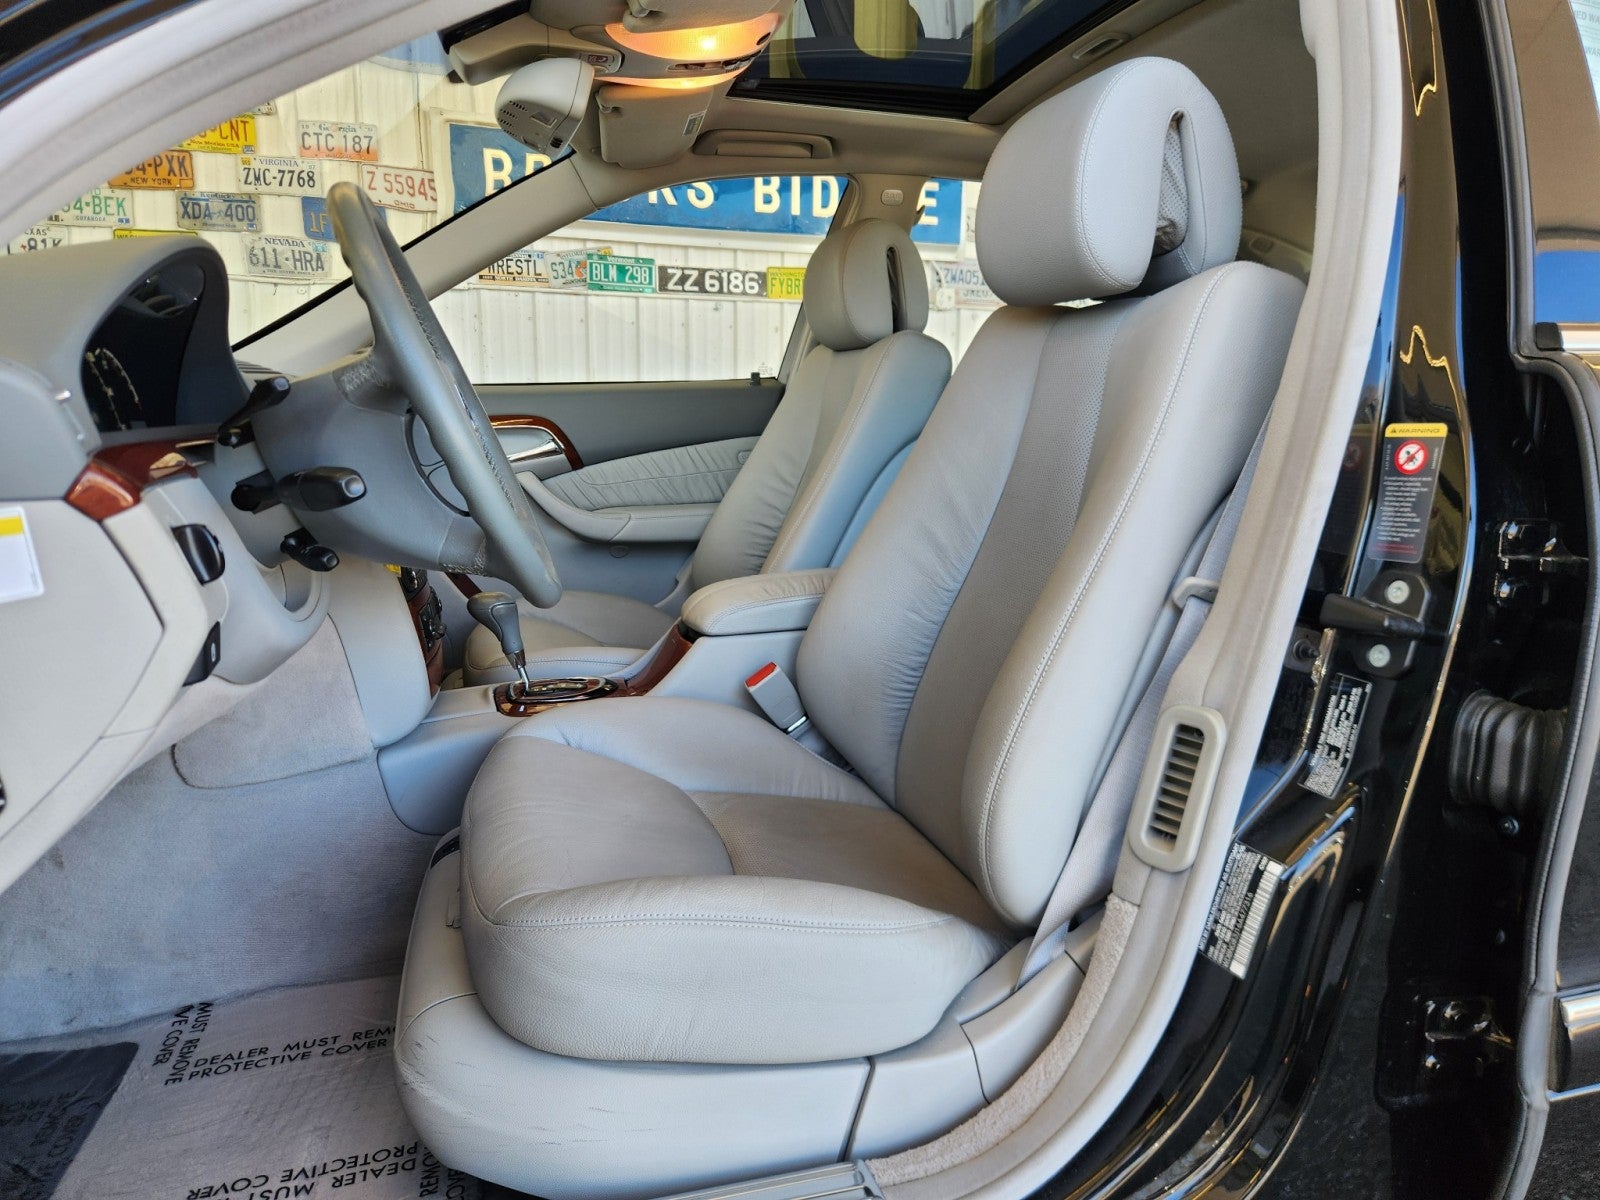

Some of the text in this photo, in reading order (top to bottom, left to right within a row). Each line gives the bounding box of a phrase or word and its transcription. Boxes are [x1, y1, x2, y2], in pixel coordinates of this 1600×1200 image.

[301, 131, 373, 155] CTC 187
[259, 158, 299, 167] VIRGINIA
[130, 177, 150, 185] NEW
[367, 171, 437, 202] Z 55945
[181, 200, 256, 222] XDA 400
[394, 200, 415, 209] OHIO
[264, 237, 306, 248] NEVADA
[607, 256, 636, 264] Vermont
[625, 265, 650, 285] 298
[667, 268, 760, 295] ZZ 6186
[192, 1002, 214, 1033] MUST
[153, 1029, 183, 1066] COVER
[188, 1038, 387, 1081] PROTECTIVE COVER
[194, 1046, 269, 1068] DEALER
[284, 1034, 341, 1051] MUST
[165, 1037, 200, 1086] REMOVE
[186, 1141, 418, 1200] PROTECTIVE COVER
[331, 1157, 416, 1188] DEALER
